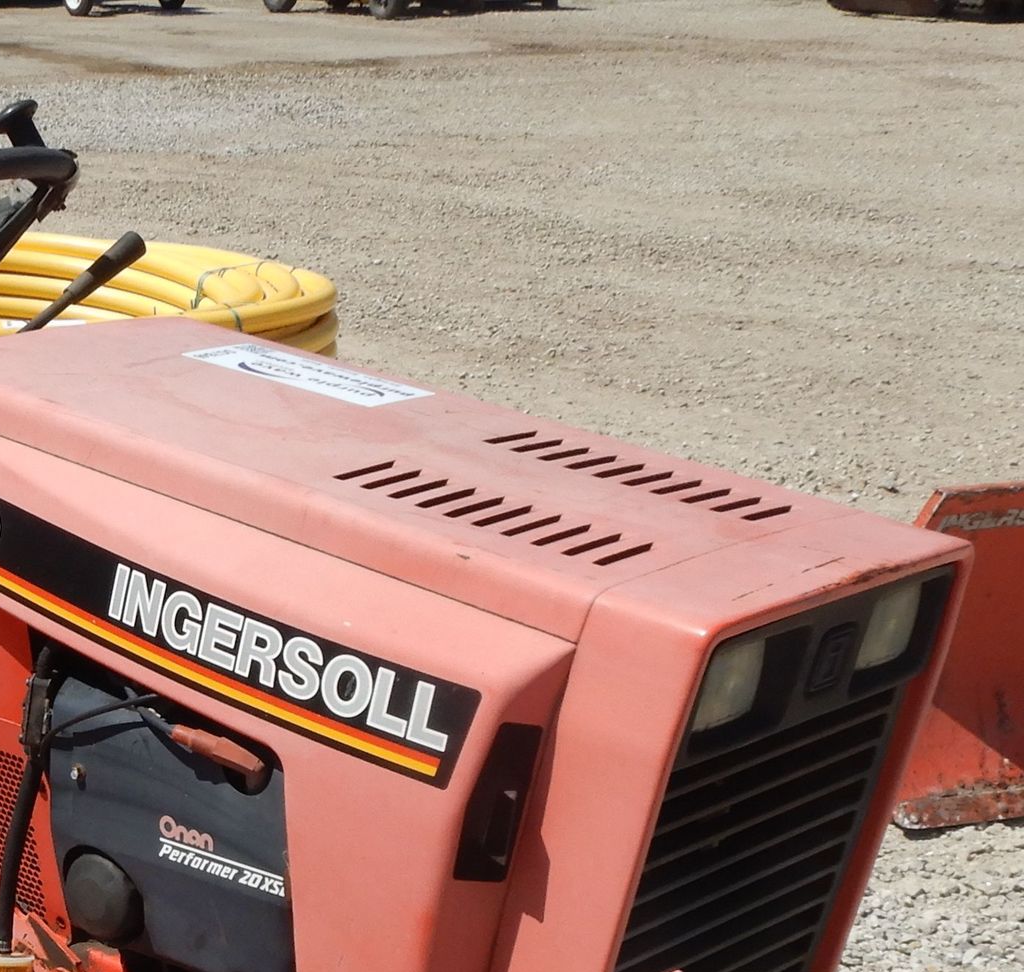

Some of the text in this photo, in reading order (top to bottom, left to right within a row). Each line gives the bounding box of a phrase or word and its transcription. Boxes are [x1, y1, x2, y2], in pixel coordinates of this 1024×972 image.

[108, 562, 449, 752] INGERSOLL
[159, 815, 214, 852] Onan
[159, 843, 238, 881] Performer
